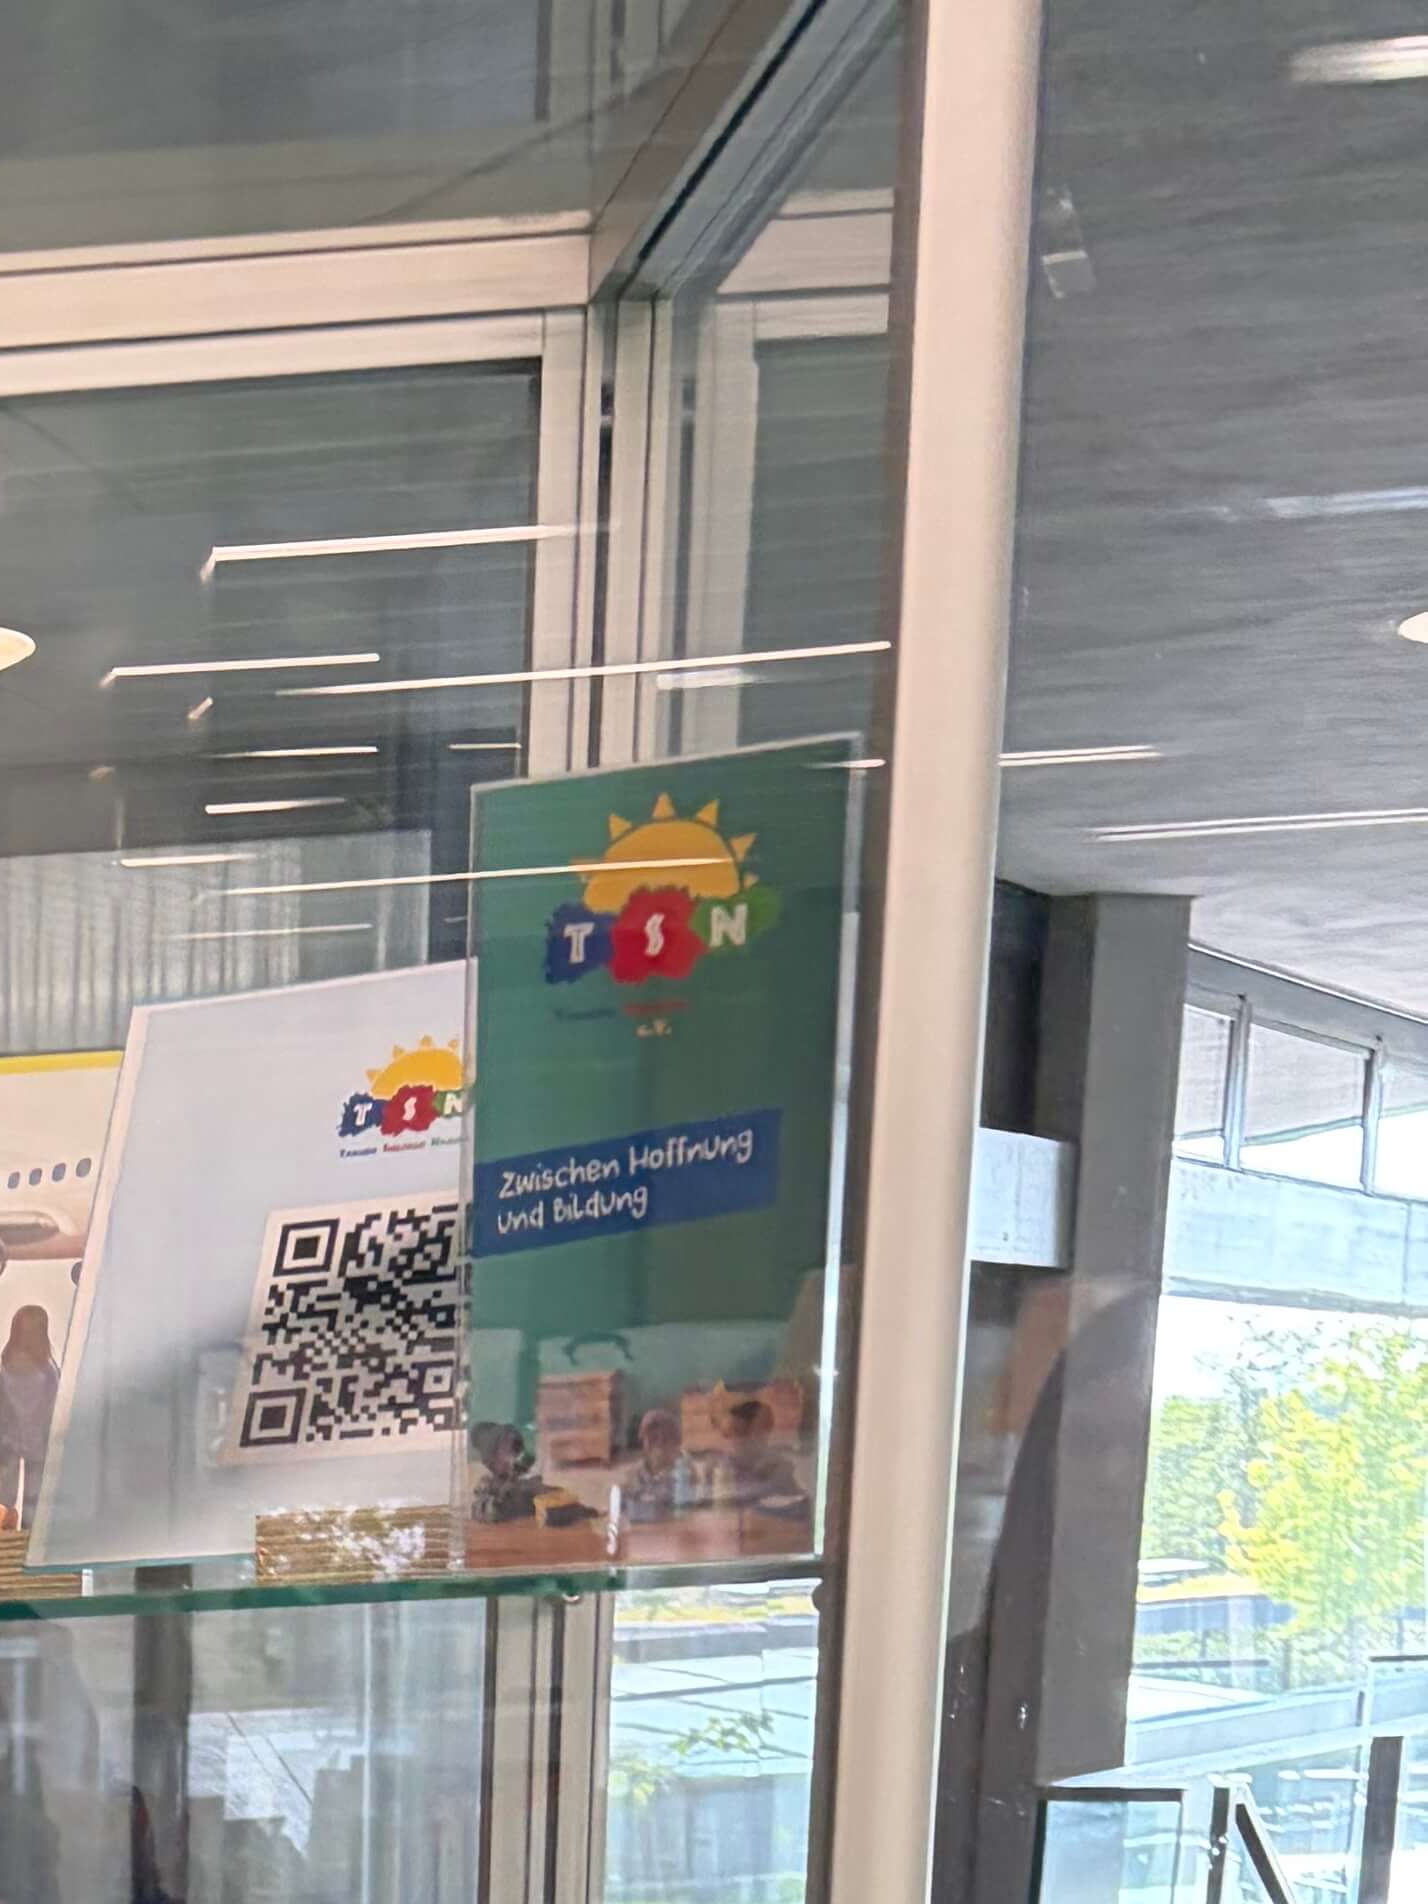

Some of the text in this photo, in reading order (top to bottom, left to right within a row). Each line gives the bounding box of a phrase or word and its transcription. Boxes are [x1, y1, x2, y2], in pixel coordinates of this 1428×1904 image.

[562, 903, 749, 964] TSN
[628, 1128, 754, 1176] Hoffnung
[552, 1186, 649, 1224] Bildung
